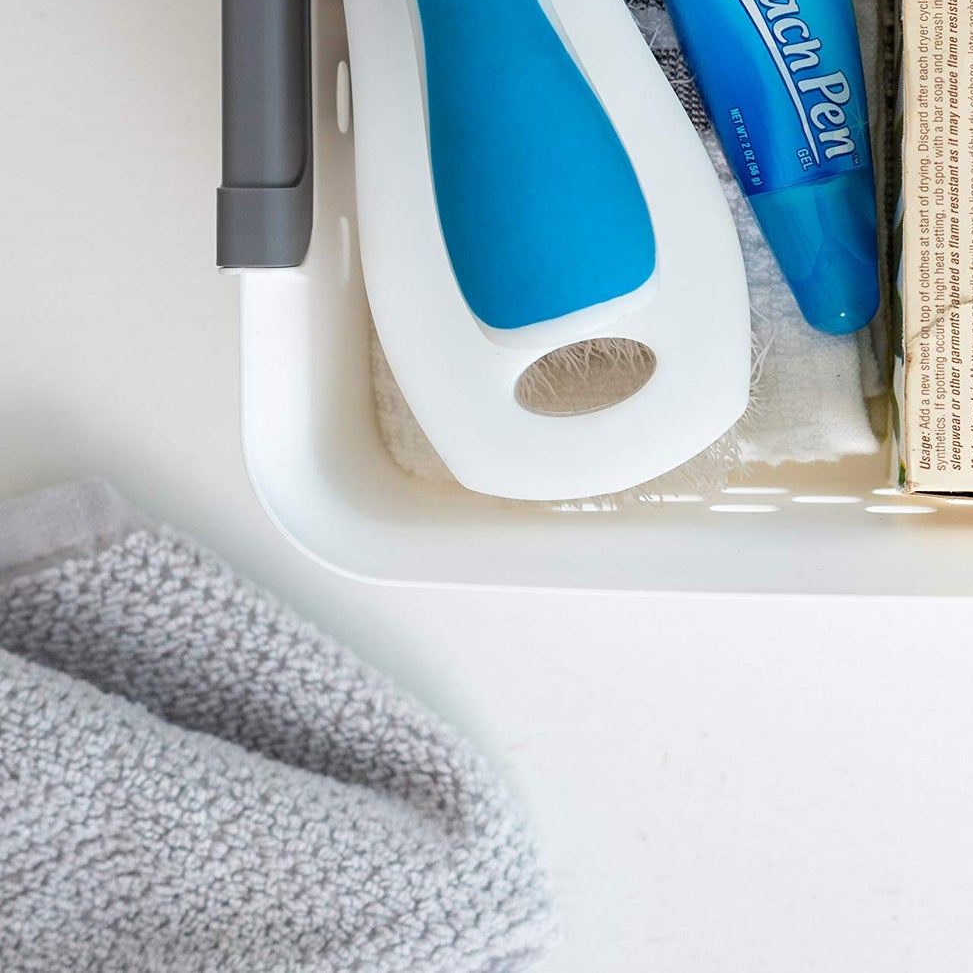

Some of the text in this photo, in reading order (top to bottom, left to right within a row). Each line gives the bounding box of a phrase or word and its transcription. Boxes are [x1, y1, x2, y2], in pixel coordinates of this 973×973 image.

[917, 25, 929, 52] dryer
[947, 37, 958, 68] flame
[917, 56, 928, 80] each
[917, 84, 928, 108] after
[947, 71, 958, 109] reduce
[730, 108, 743, 124] NET
[950, 112, 960, 135] may
[735, 125, 748, 141] WT.
[947, 138, 958, 146] it
[744, 150, 755, 161] OZ
[797, 148, 813, 171] GEL
[950, 150, 958, 162] as
[746, 162, 759, 176] (56
[918, 156, 930, 192] drying.
[948, 165, 959, 213] resistant
[918, 196, 929, 206] of
[919, 210, 929, 233] start
[949, 217, 959, 248] flame
[920, 237, 930, 247] at
[919, 250, 930, 288] clothes
[951, 252, 959, 265] as
[918, 291, 930, 302] of
[948, 267, 960, 309] labeled
[920, 306, 931, 322] top
[920, 326, 930, 339] on
[949, 312, 962, 364] garments
[919, 342, 930, 370] sheet
[921, 374, 930, 395] new
[950, 367, 960, 395] other
[952, 398, 960, 410] or
[919, 409, 930, 429] Add
[919, 432, 932, 469] Usage:
[950, 413, 963, 470] sleepwear
